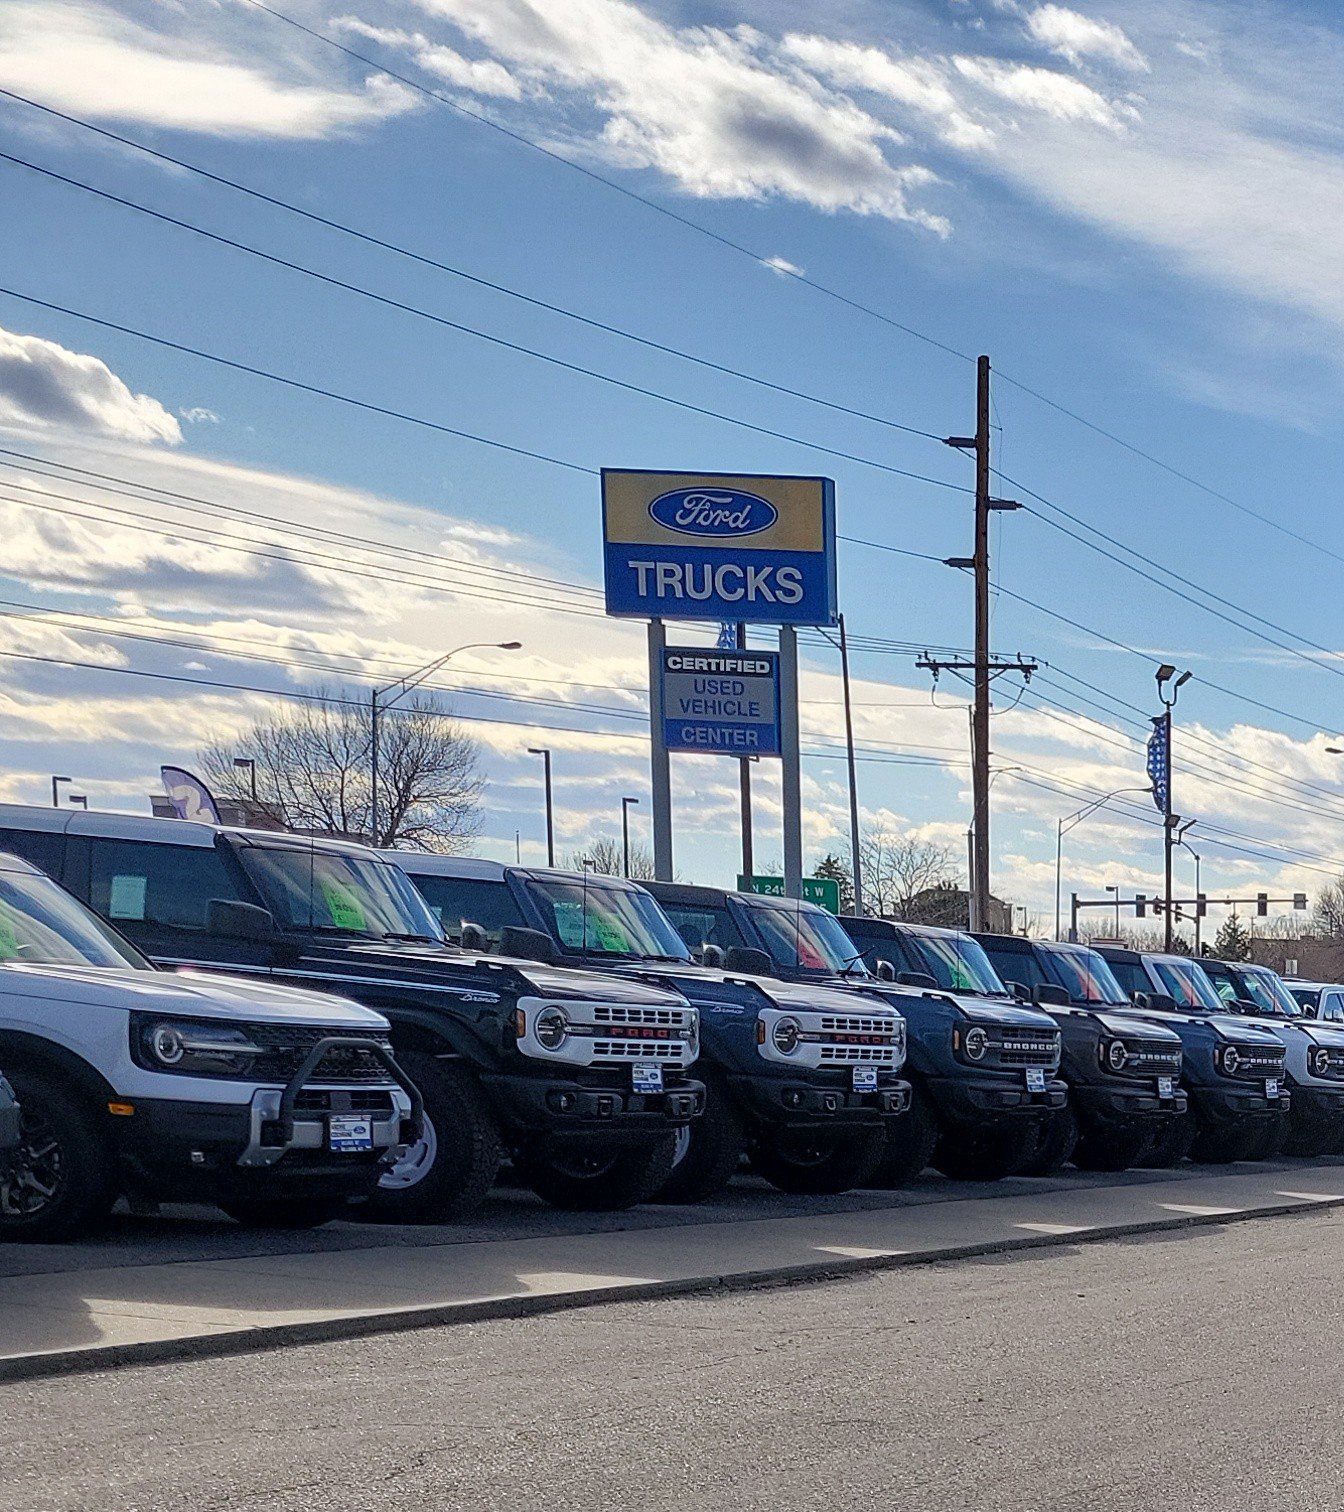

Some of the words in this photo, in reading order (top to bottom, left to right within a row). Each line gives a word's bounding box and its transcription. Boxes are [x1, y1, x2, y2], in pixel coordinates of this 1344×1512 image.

[675, 493, 752, 530] Ford
[628, 560, 804, 604] TRUCKS
[667, 656, 770, 674] CERTIFIED
[694, 678, 745, 696] USED
[680, 698, 760, 717] VEHICLE
[681, 726, 759, 746] CENTER
[764, 885, 786, 895] 24t
[814, 887, 824, 897] W
[1003, 1042, 1053, 1050] BRONCO
